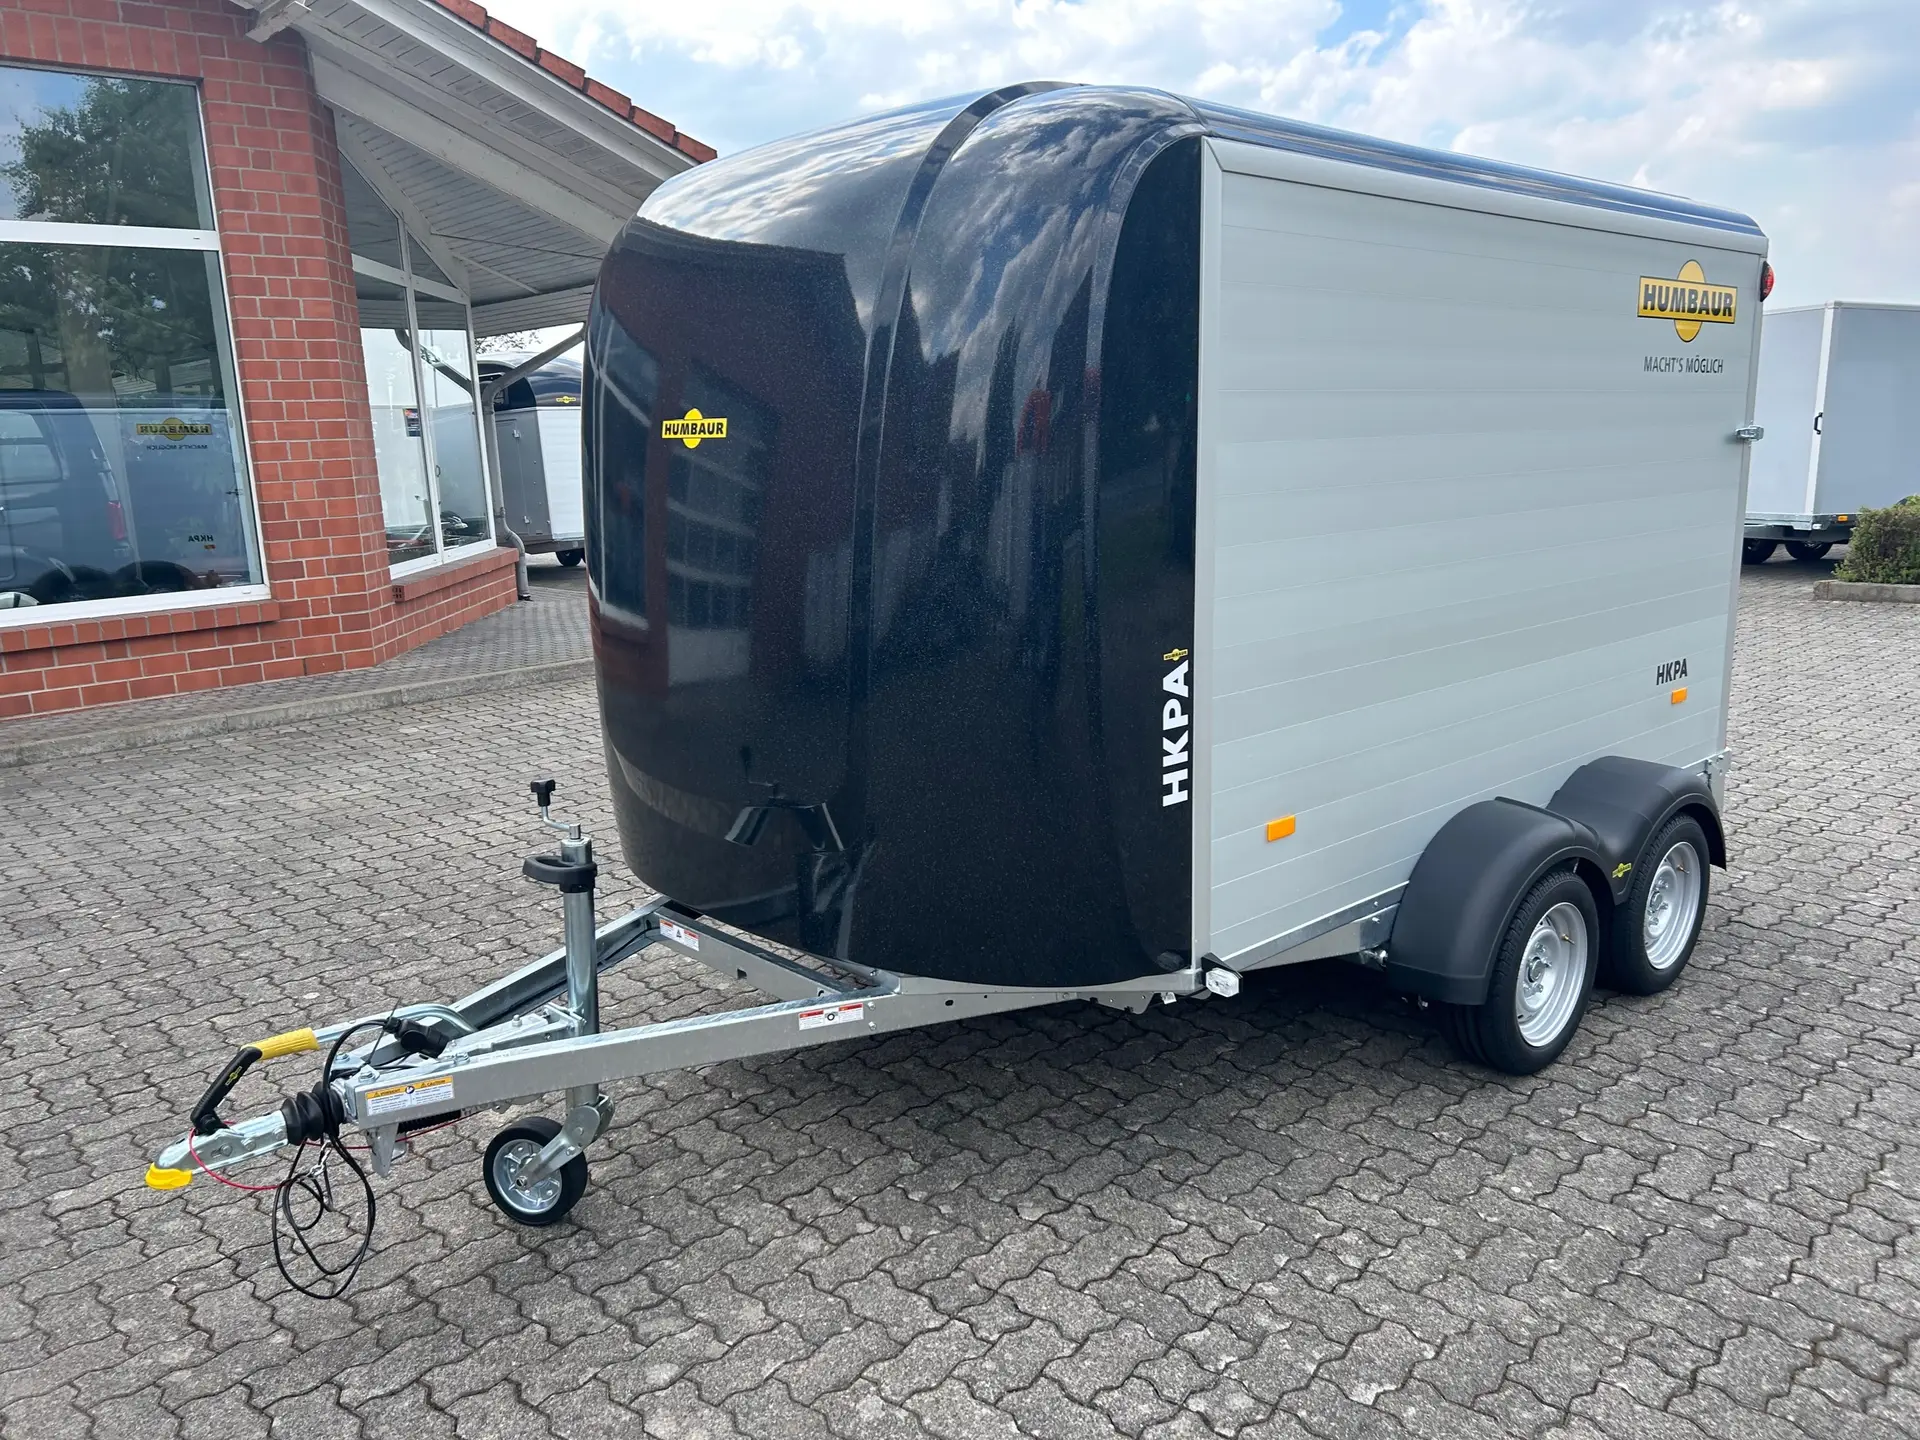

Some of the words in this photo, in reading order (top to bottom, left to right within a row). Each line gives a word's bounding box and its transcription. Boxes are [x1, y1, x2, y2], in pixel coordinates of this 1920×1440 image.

[1643, 284, 1733, 317] HUMBAUR
[1643, 356, 1683, 373] MACHT'S
[1685, 355, 1724, 374] MÖGLICH
[664, 422, 724, 436] HUMBAUR
[1656, 658, 1688, 685] HKPA
[1162, 659, 1189, 807] HKPA
